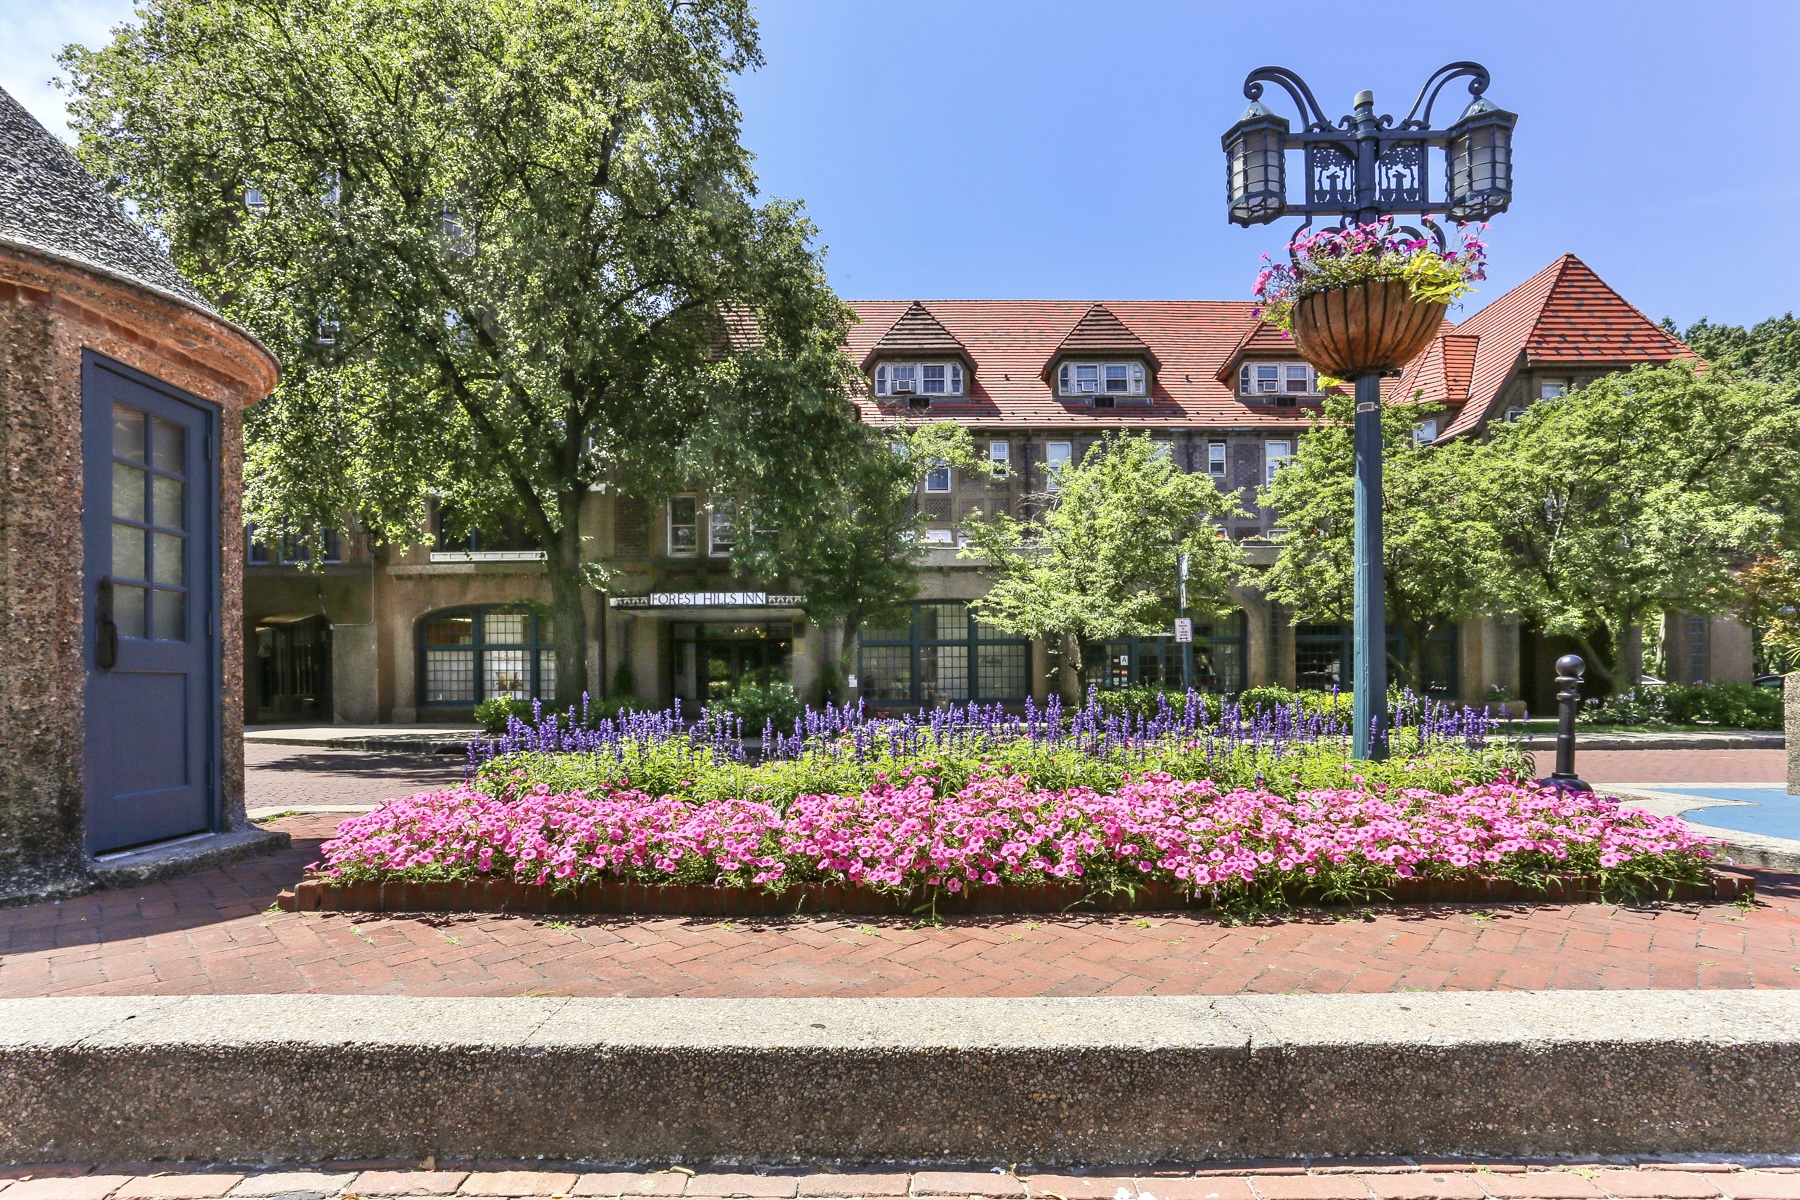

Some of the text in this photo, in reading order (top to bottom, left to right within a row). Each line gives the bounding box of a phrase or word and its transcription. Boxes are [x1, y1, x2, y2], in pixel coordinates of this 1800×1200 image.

[652, 592, 764, 605] FOREST HILLS INN
